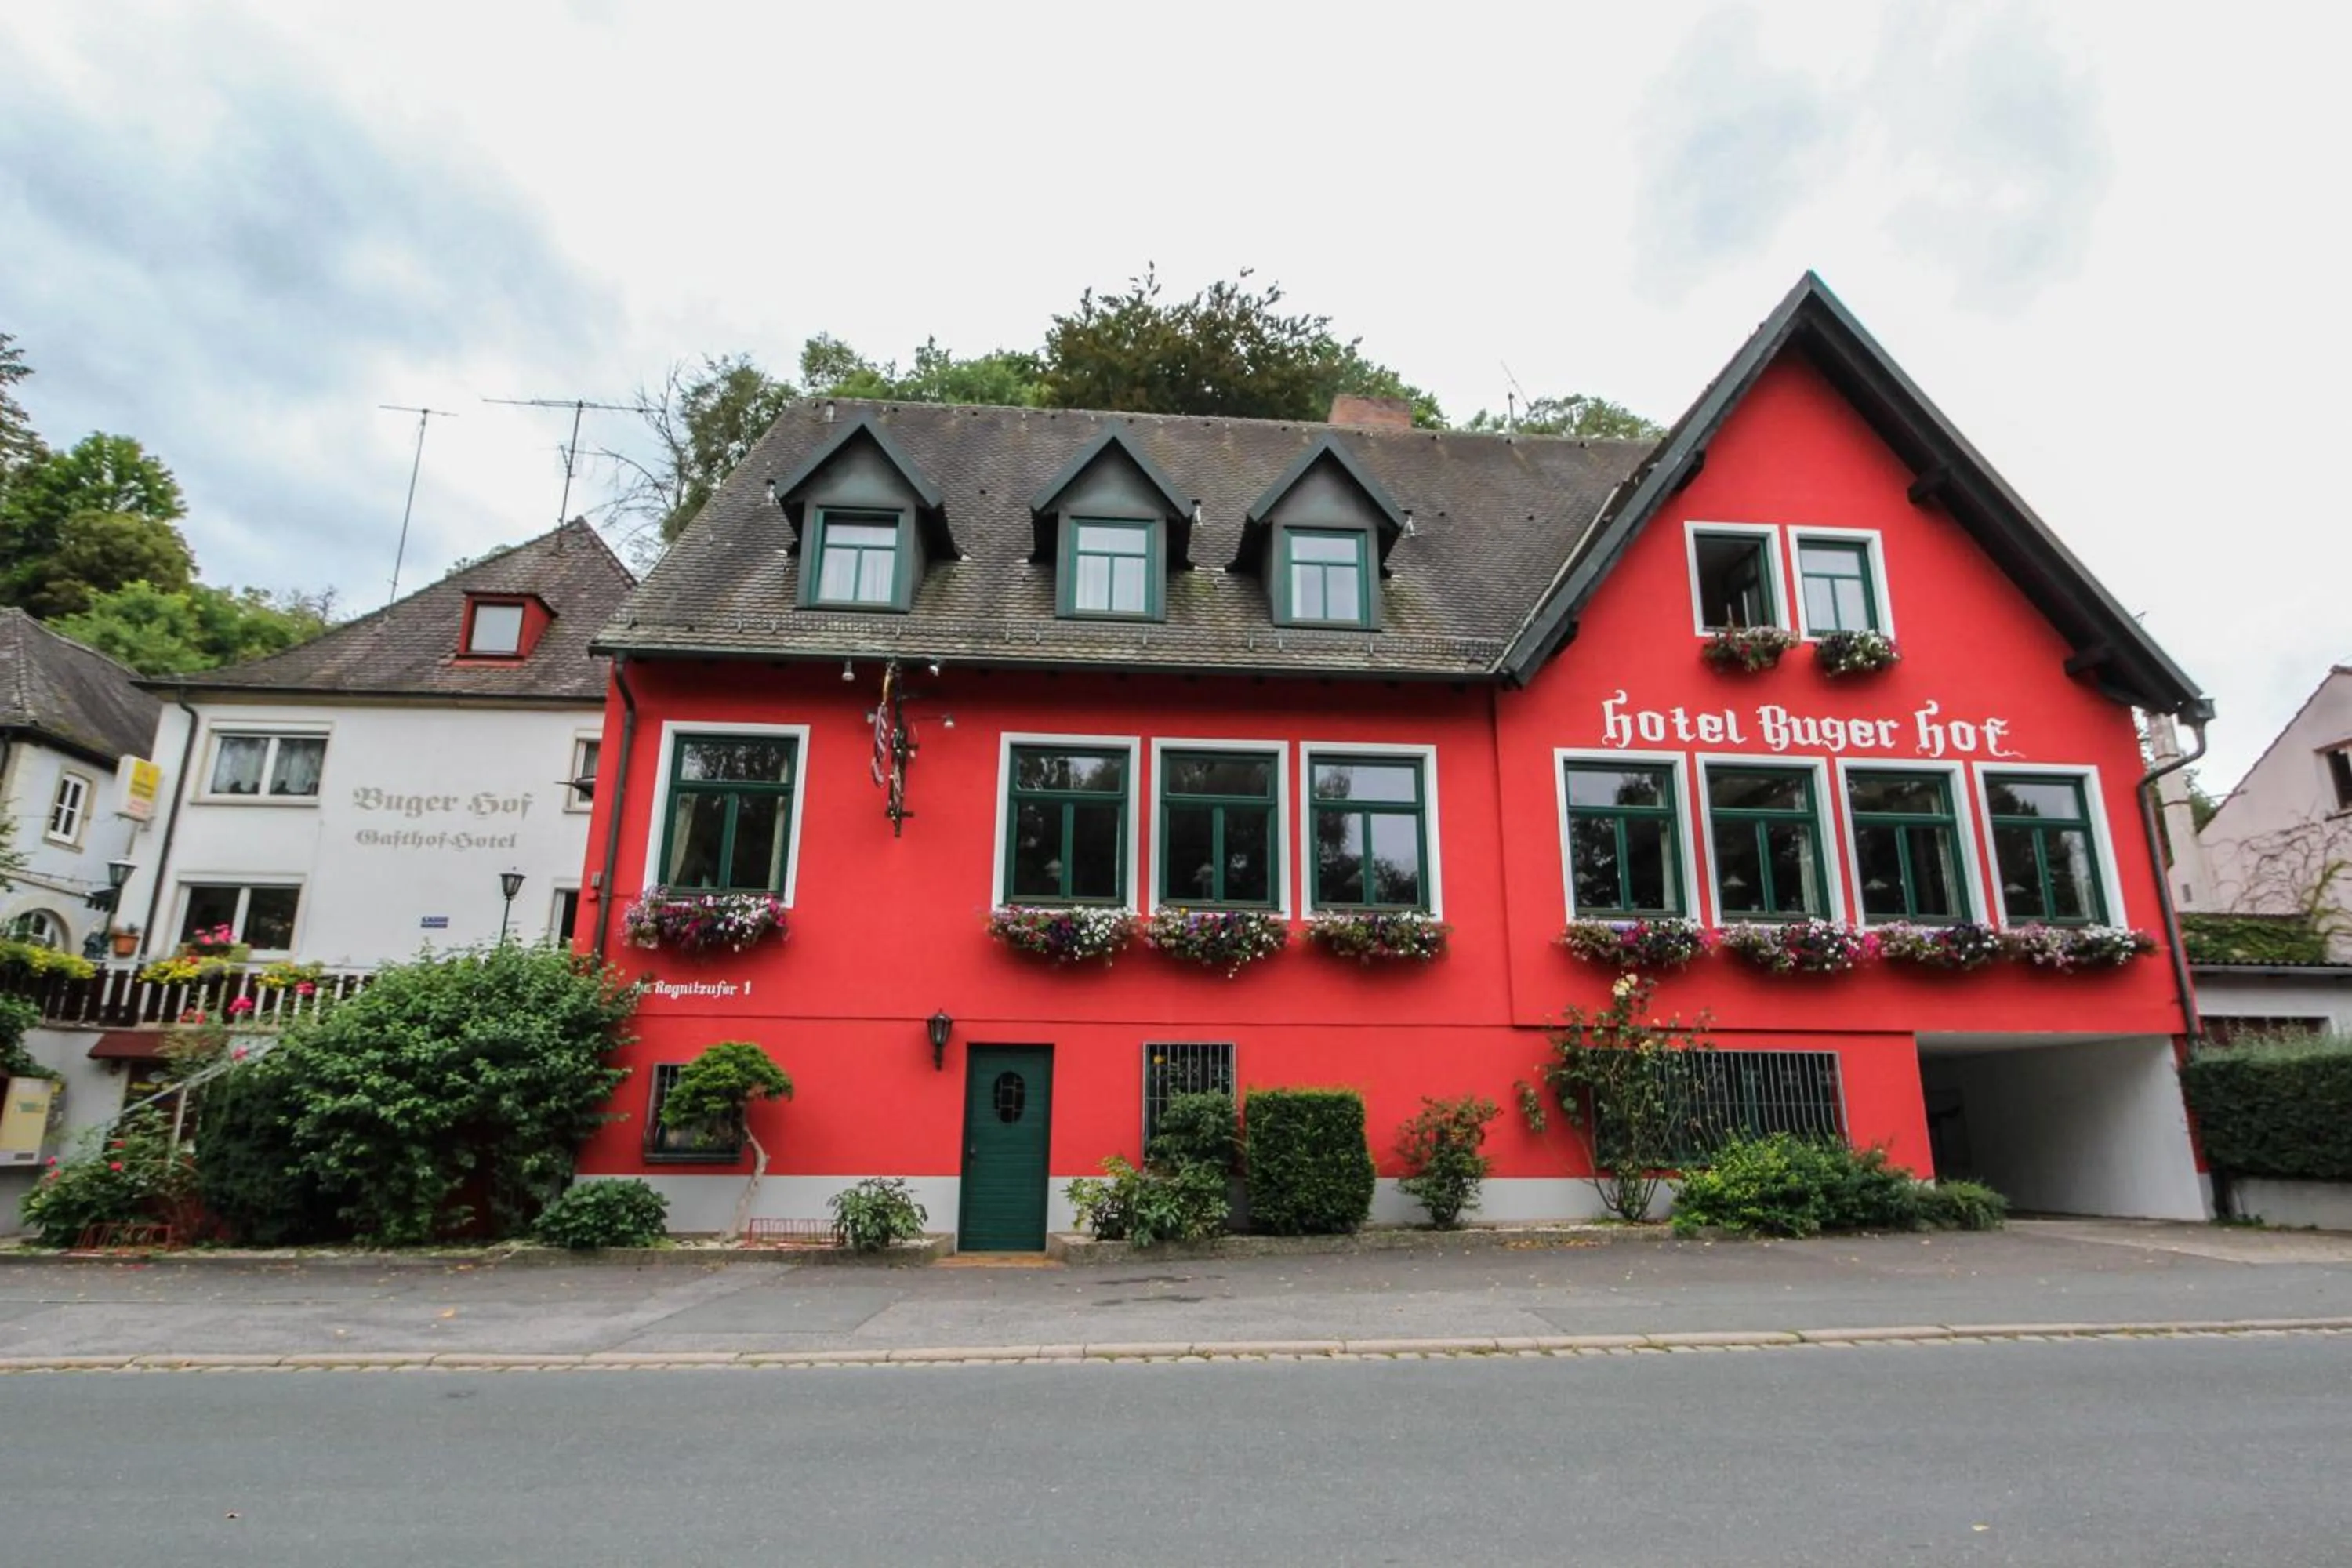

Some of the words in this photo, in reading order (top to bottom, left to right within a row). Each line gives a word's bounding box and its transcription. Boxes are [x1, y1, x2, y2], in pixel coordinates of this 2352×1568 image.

[1755, 704, 1900, 753] Buger
[353, 786, 458, 818] Buger
[467, 792, 533, 821] Hof
[655, 980, 738, 1000] Regnitzufer
[743, 980, 751, 996] 1
